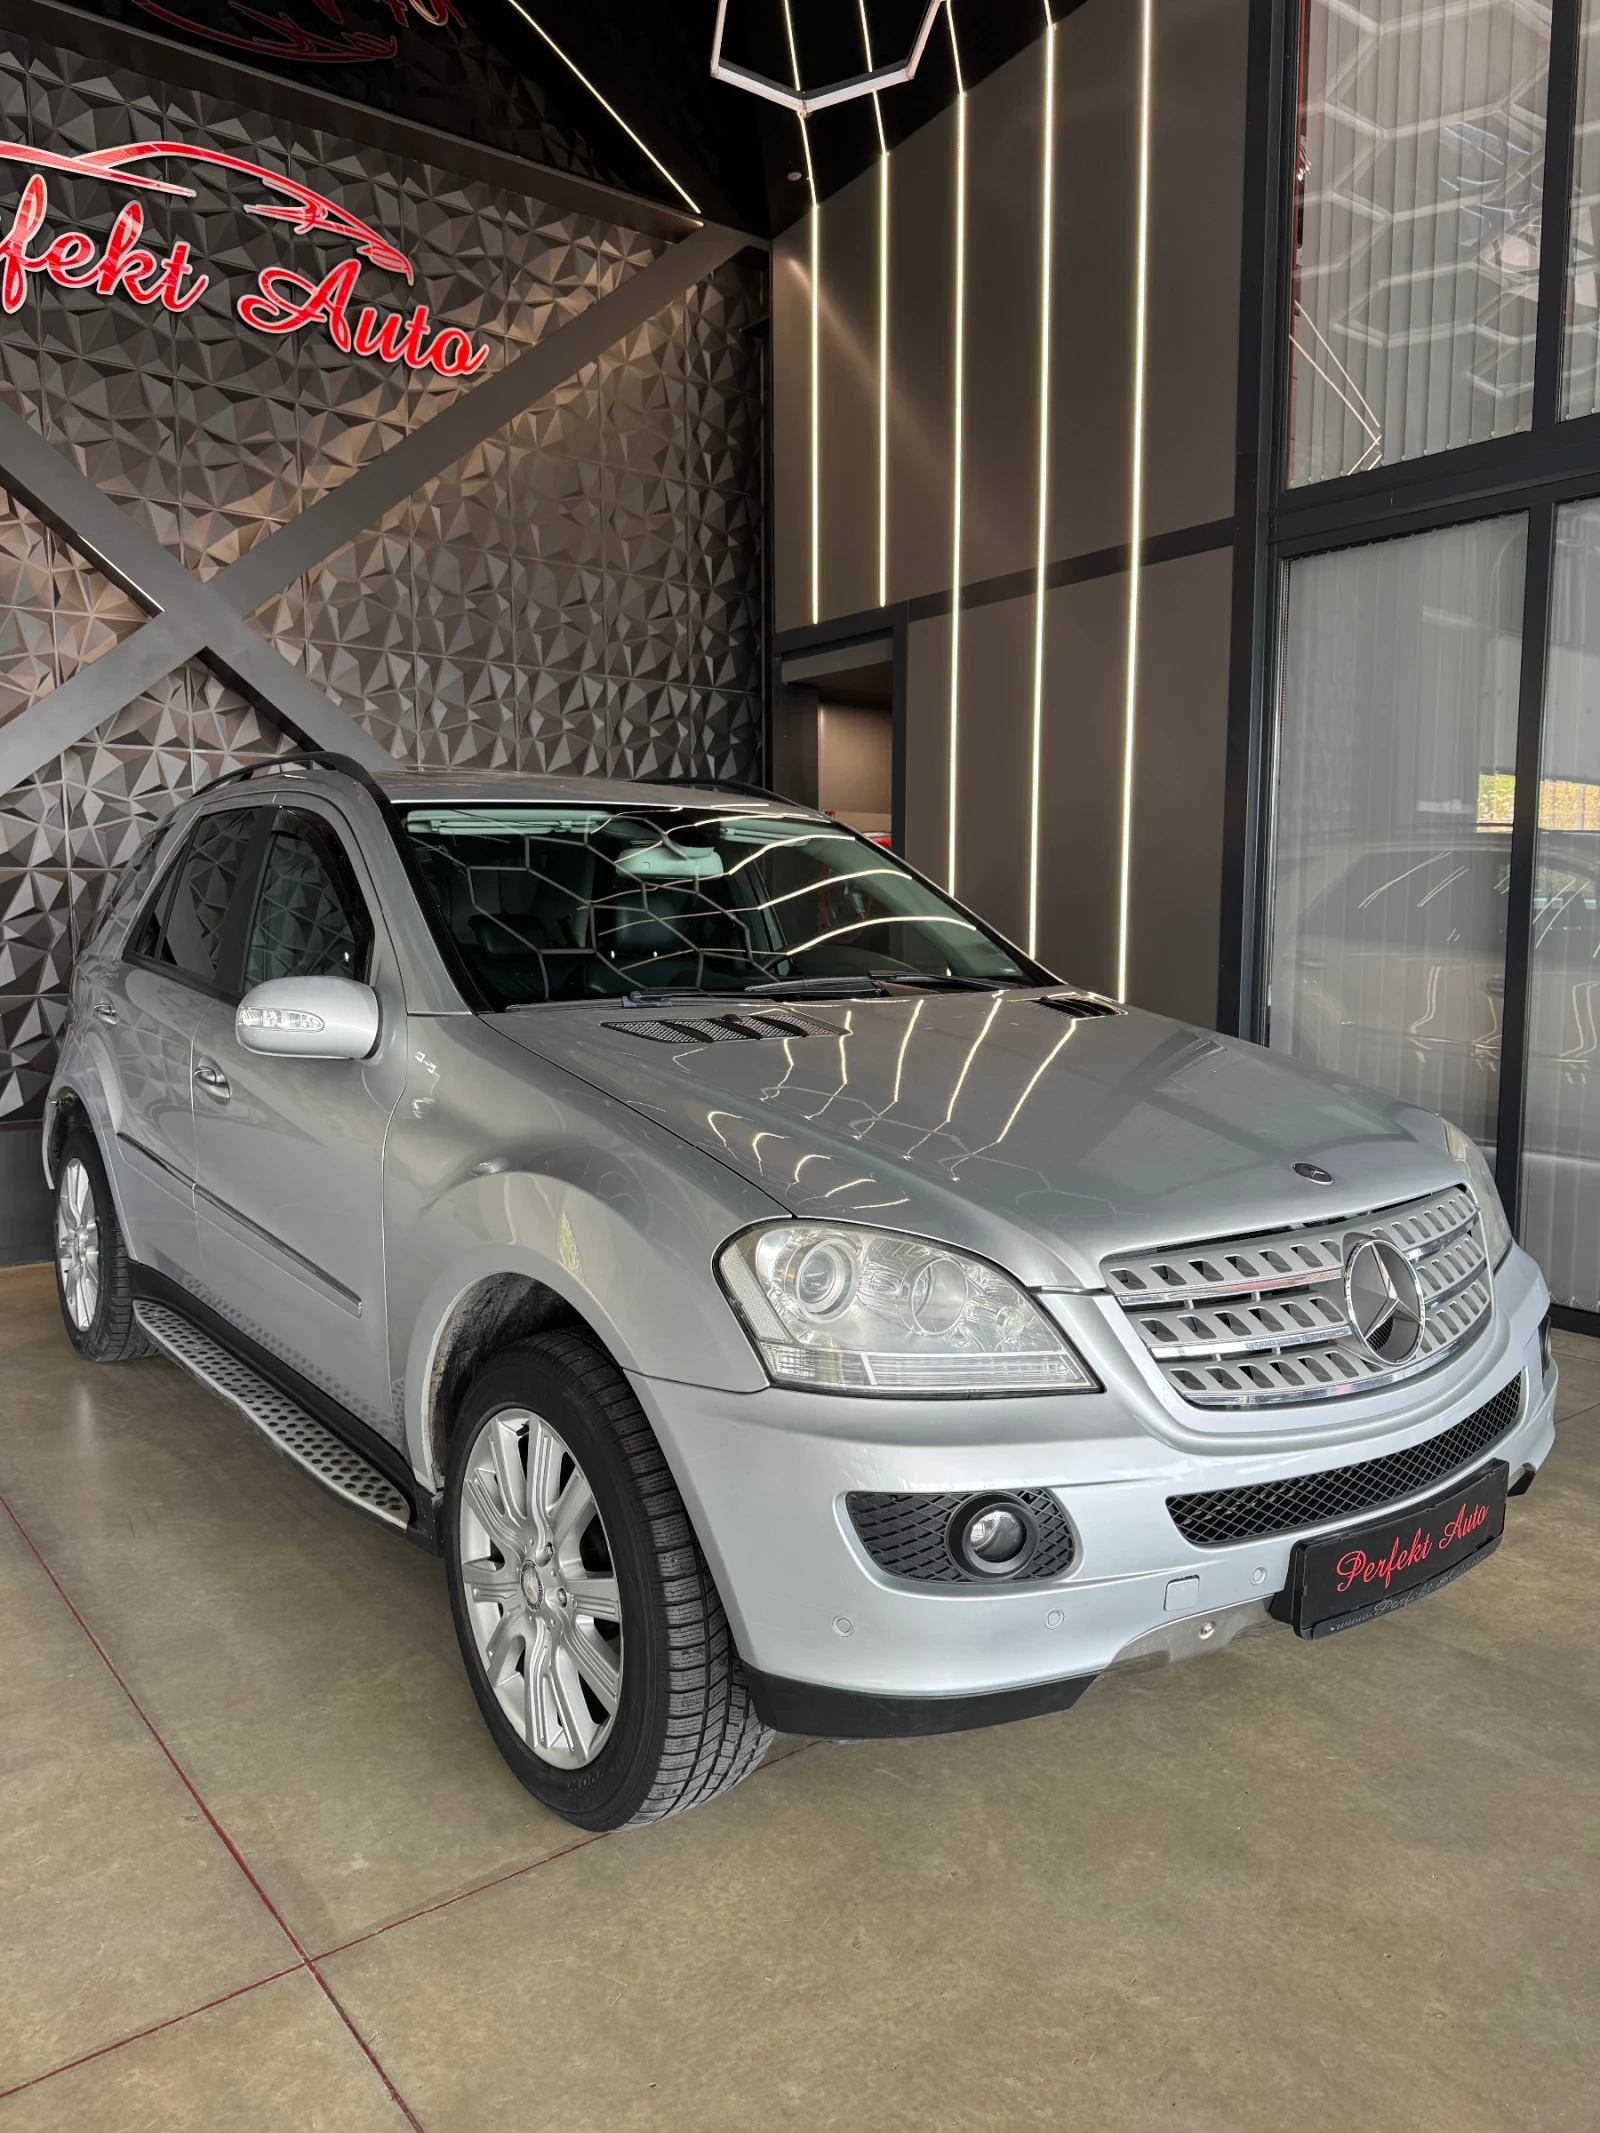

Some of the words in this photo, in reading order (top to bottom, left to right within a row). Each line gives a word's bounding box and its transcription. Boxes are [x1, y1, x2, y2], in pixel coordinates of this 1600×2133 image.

[0, 174, 209, 313] fekt
[237, 259, 490, 377] Auto
[1336, 1527, 1432, 1592] Perfekt
[1438, 1503, 1490, 1550] Auto
